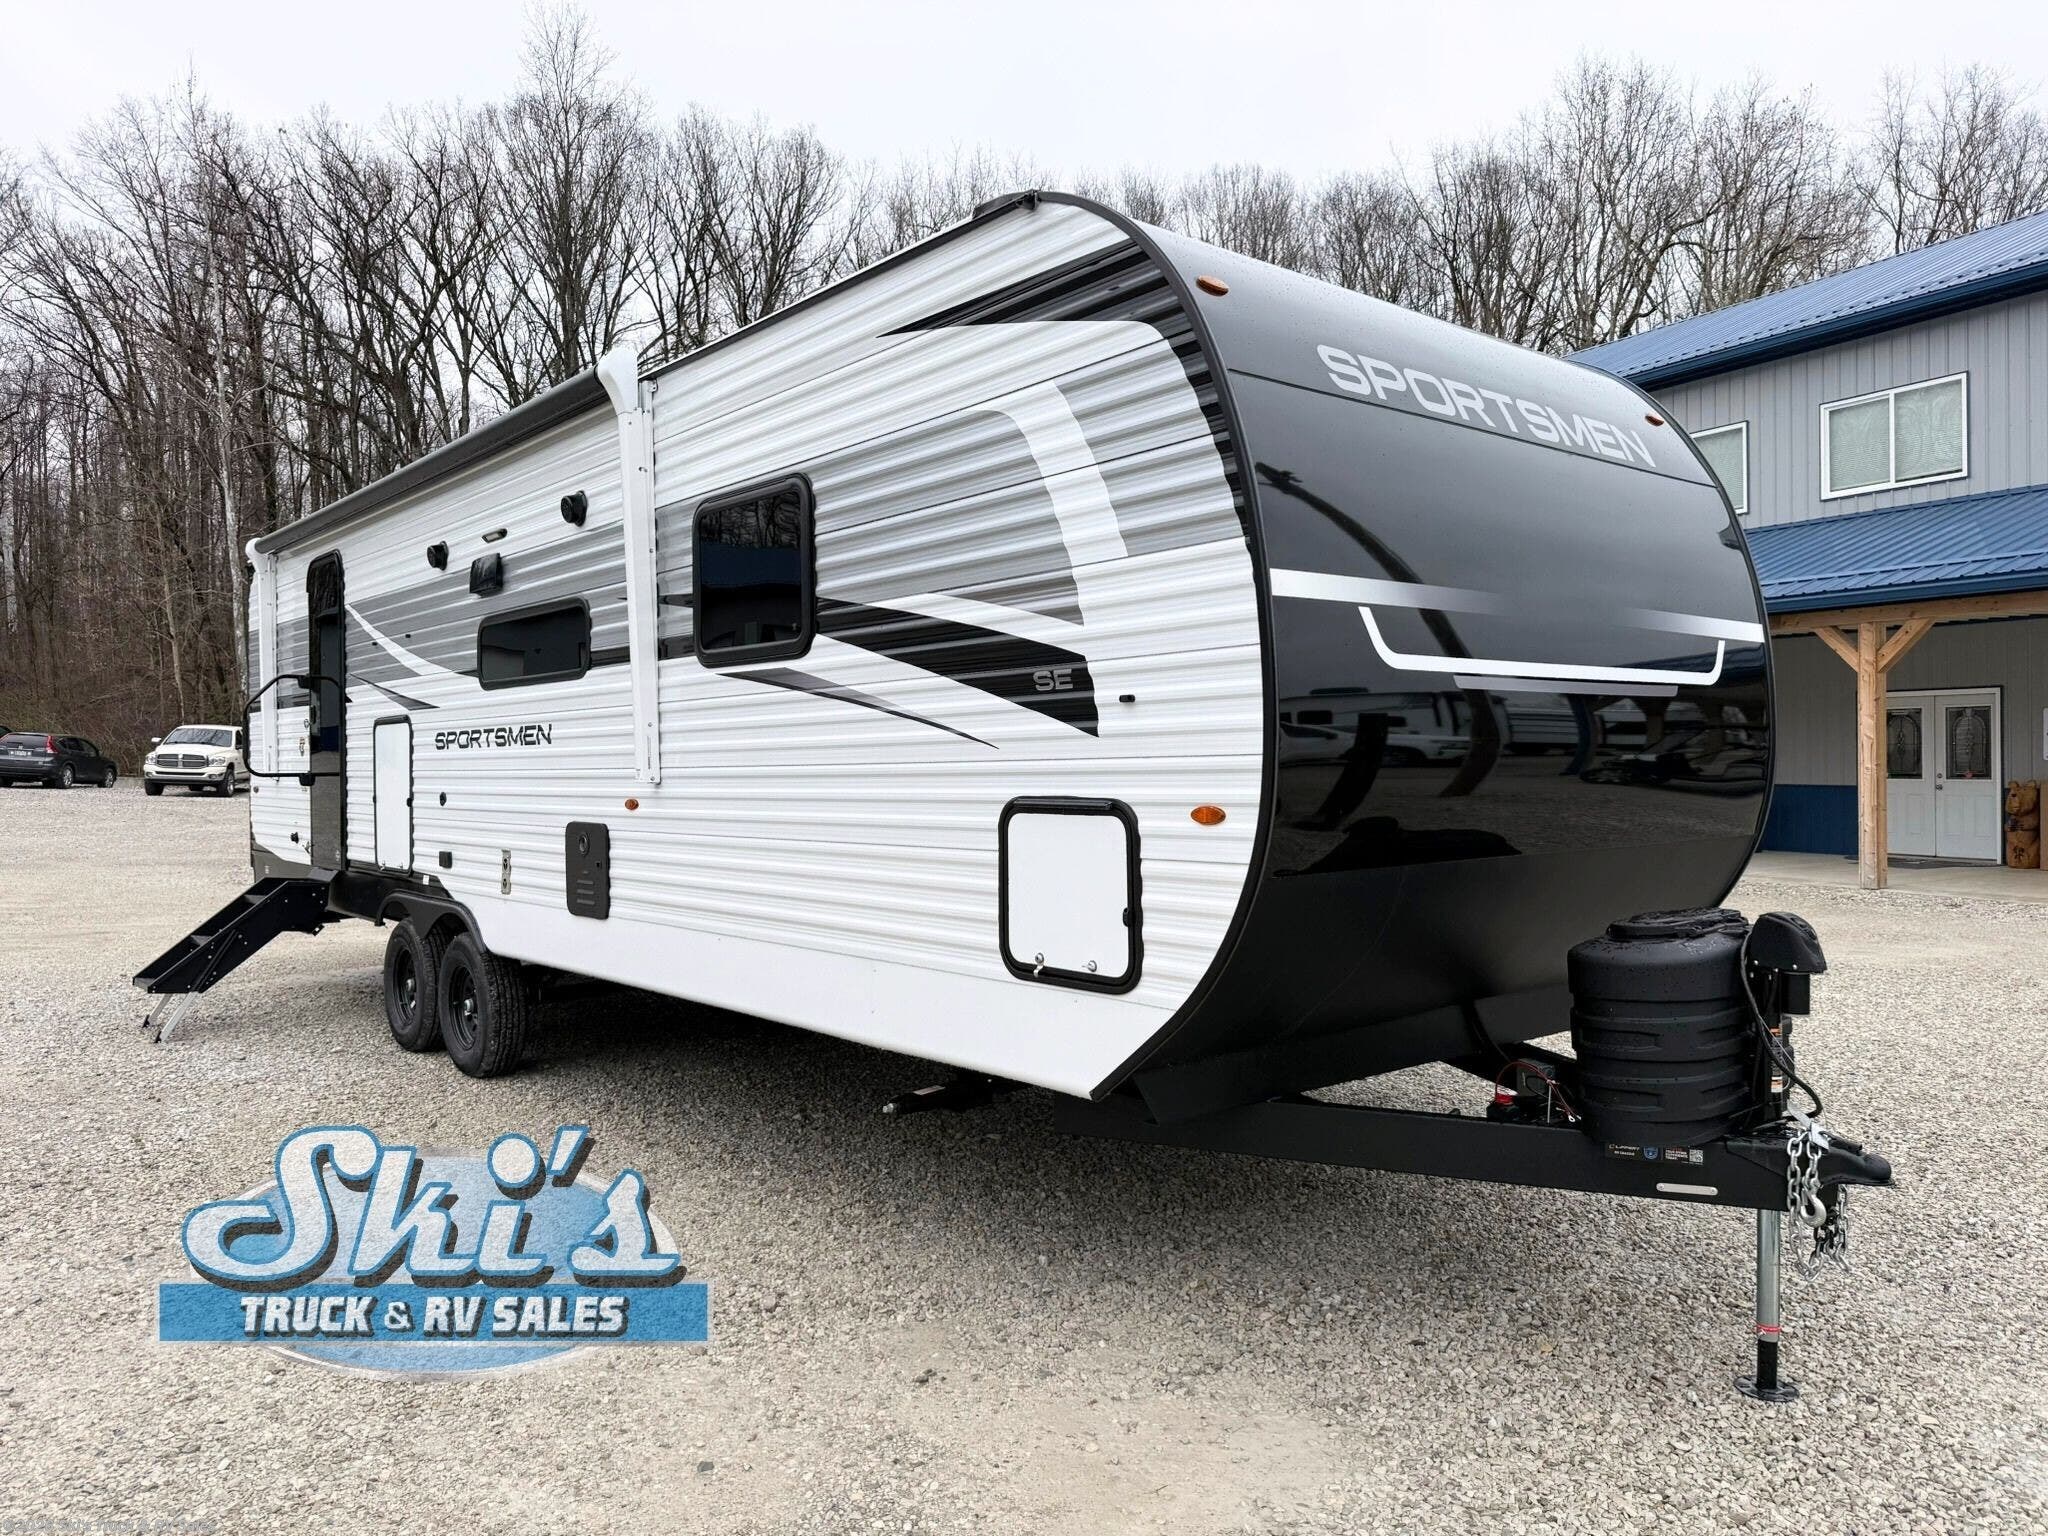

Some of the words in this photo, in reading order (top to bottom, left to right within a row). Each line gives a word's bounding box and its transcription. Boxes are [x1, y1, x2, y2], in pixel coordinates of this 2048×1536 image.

[1316, 344, 1656, 467] SPORTSMEN
[1033, 668, 1074, 691] SE
[435, 724, 552, 750] SPORTSMEN
